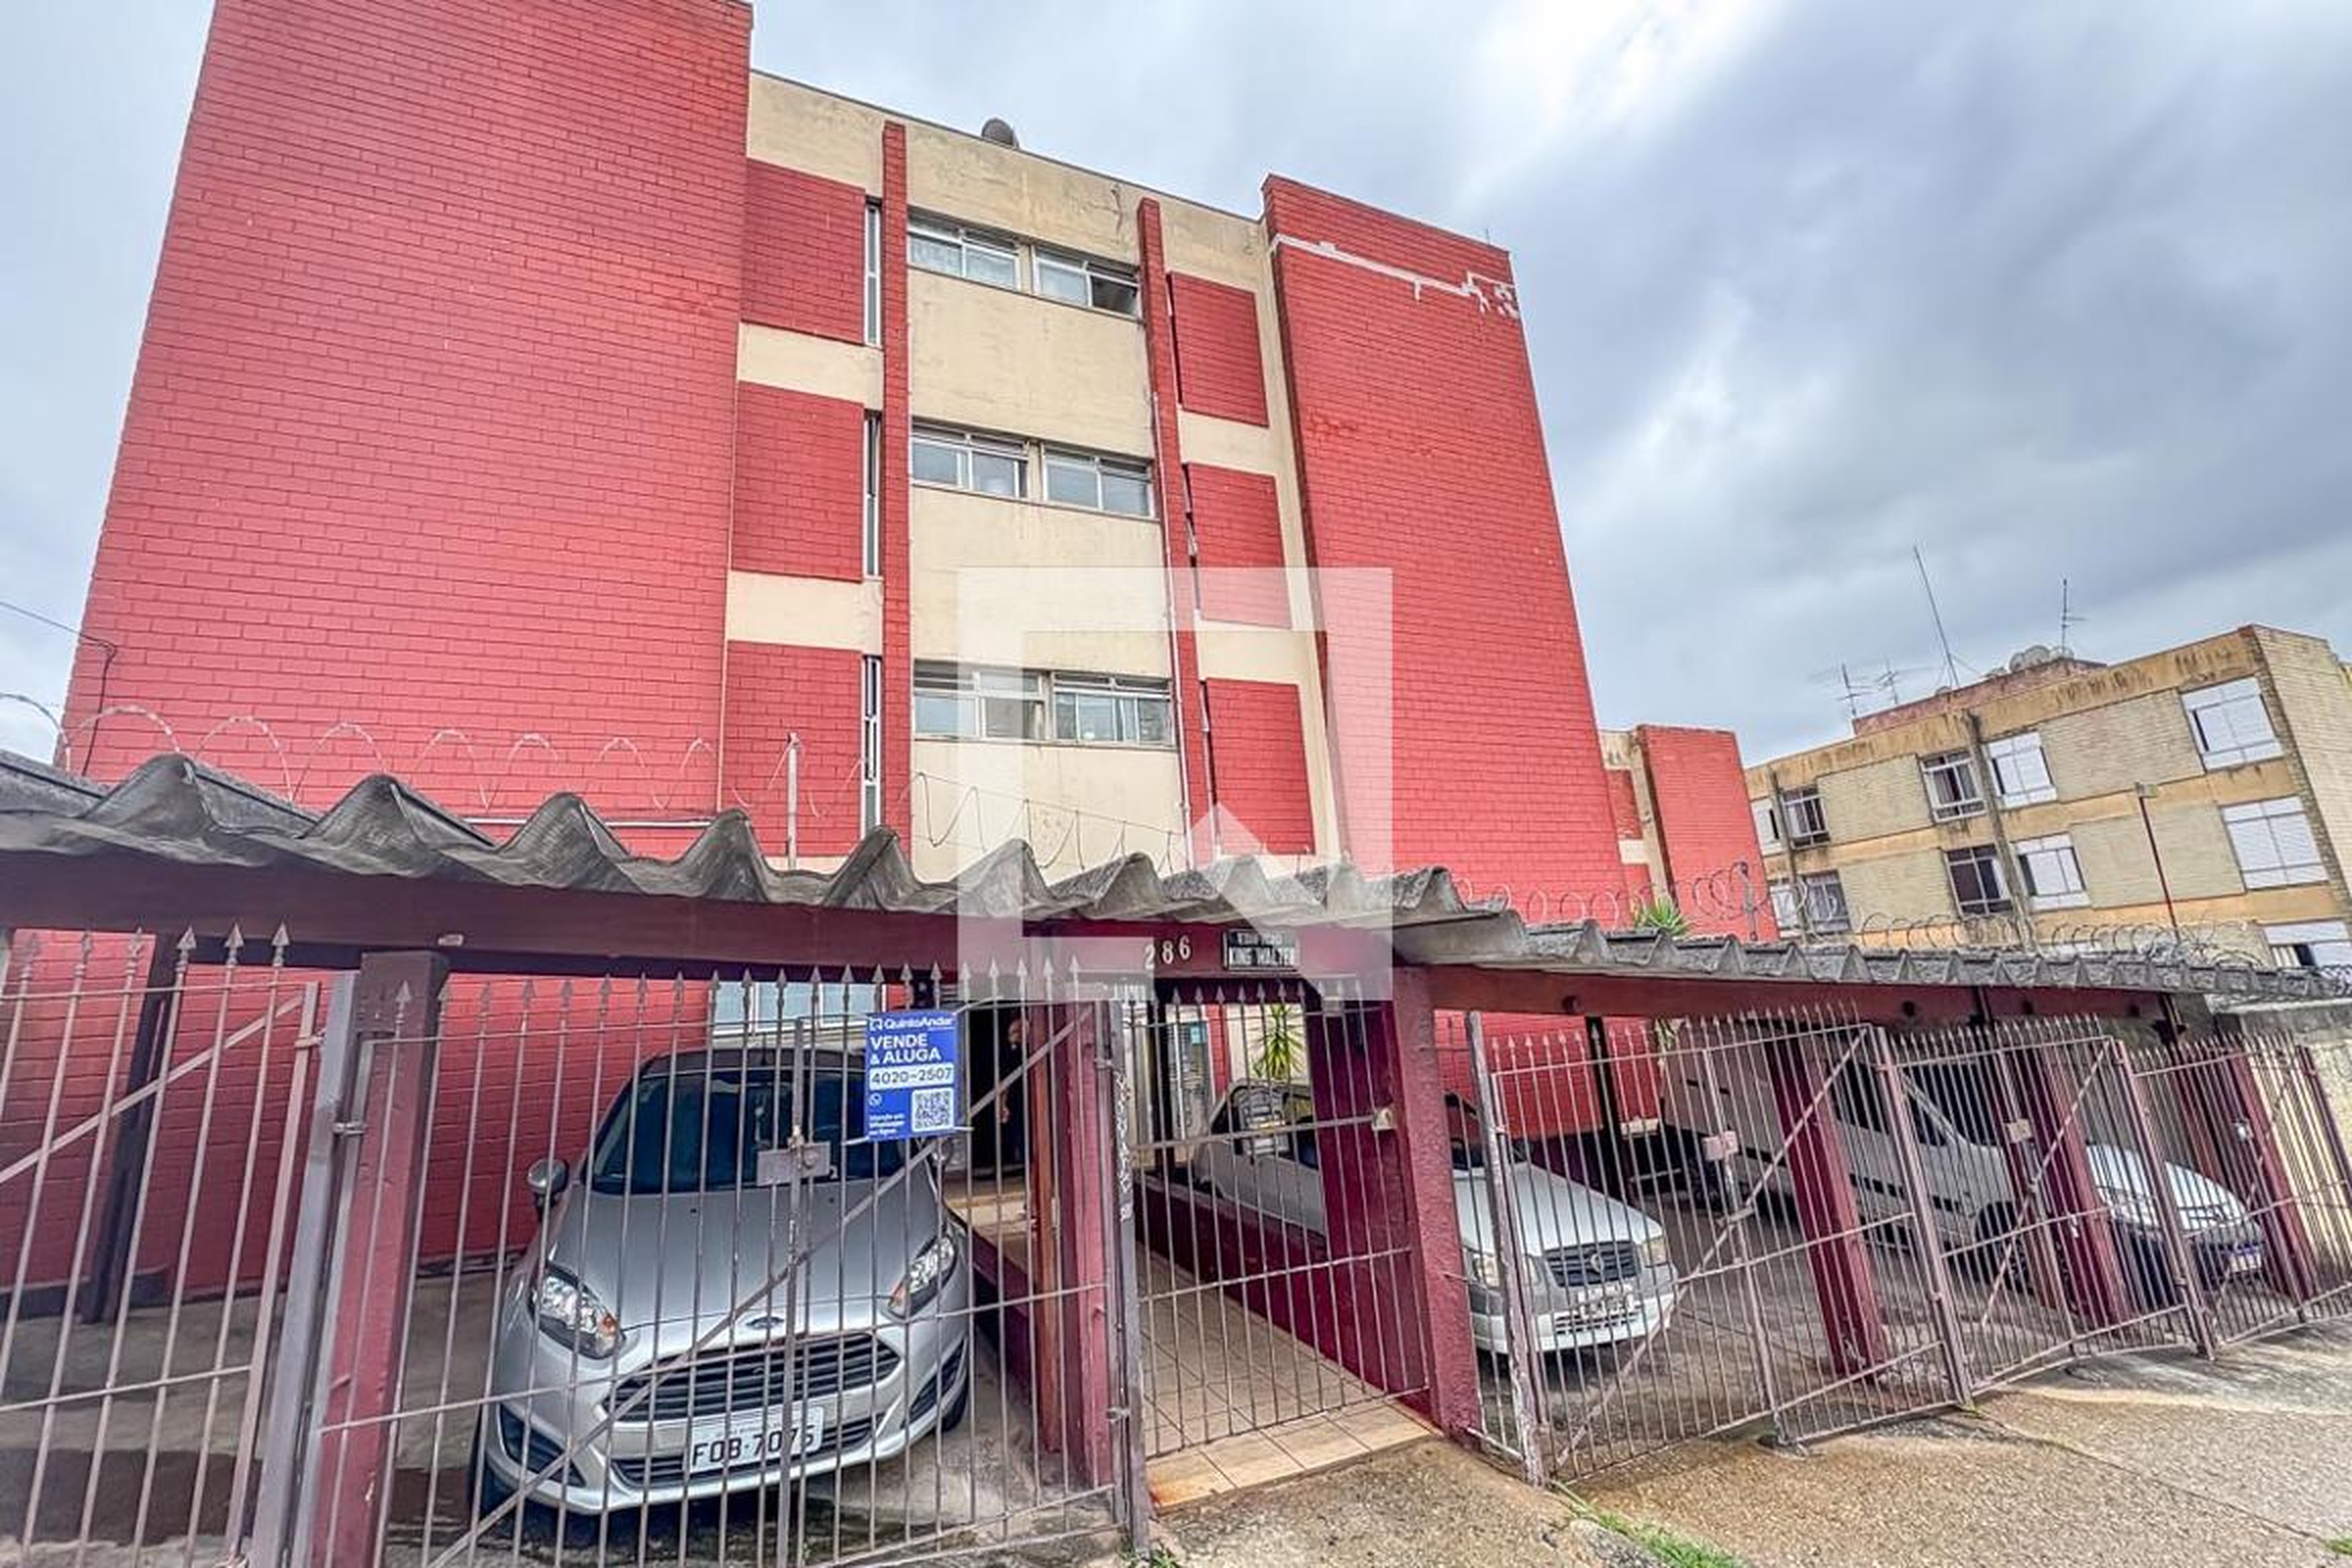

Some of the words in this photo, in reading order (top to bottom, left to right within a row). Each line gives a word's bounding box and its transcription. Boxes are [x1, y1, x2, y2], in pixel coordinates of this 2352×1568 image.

[1144, 935, 1191, 969] 286
[870, 1033, 928, 1050] VENDE
[883, 1048, 941, 1064] ALUGA
[871, 1067, 952, 1084] 4020-2507
